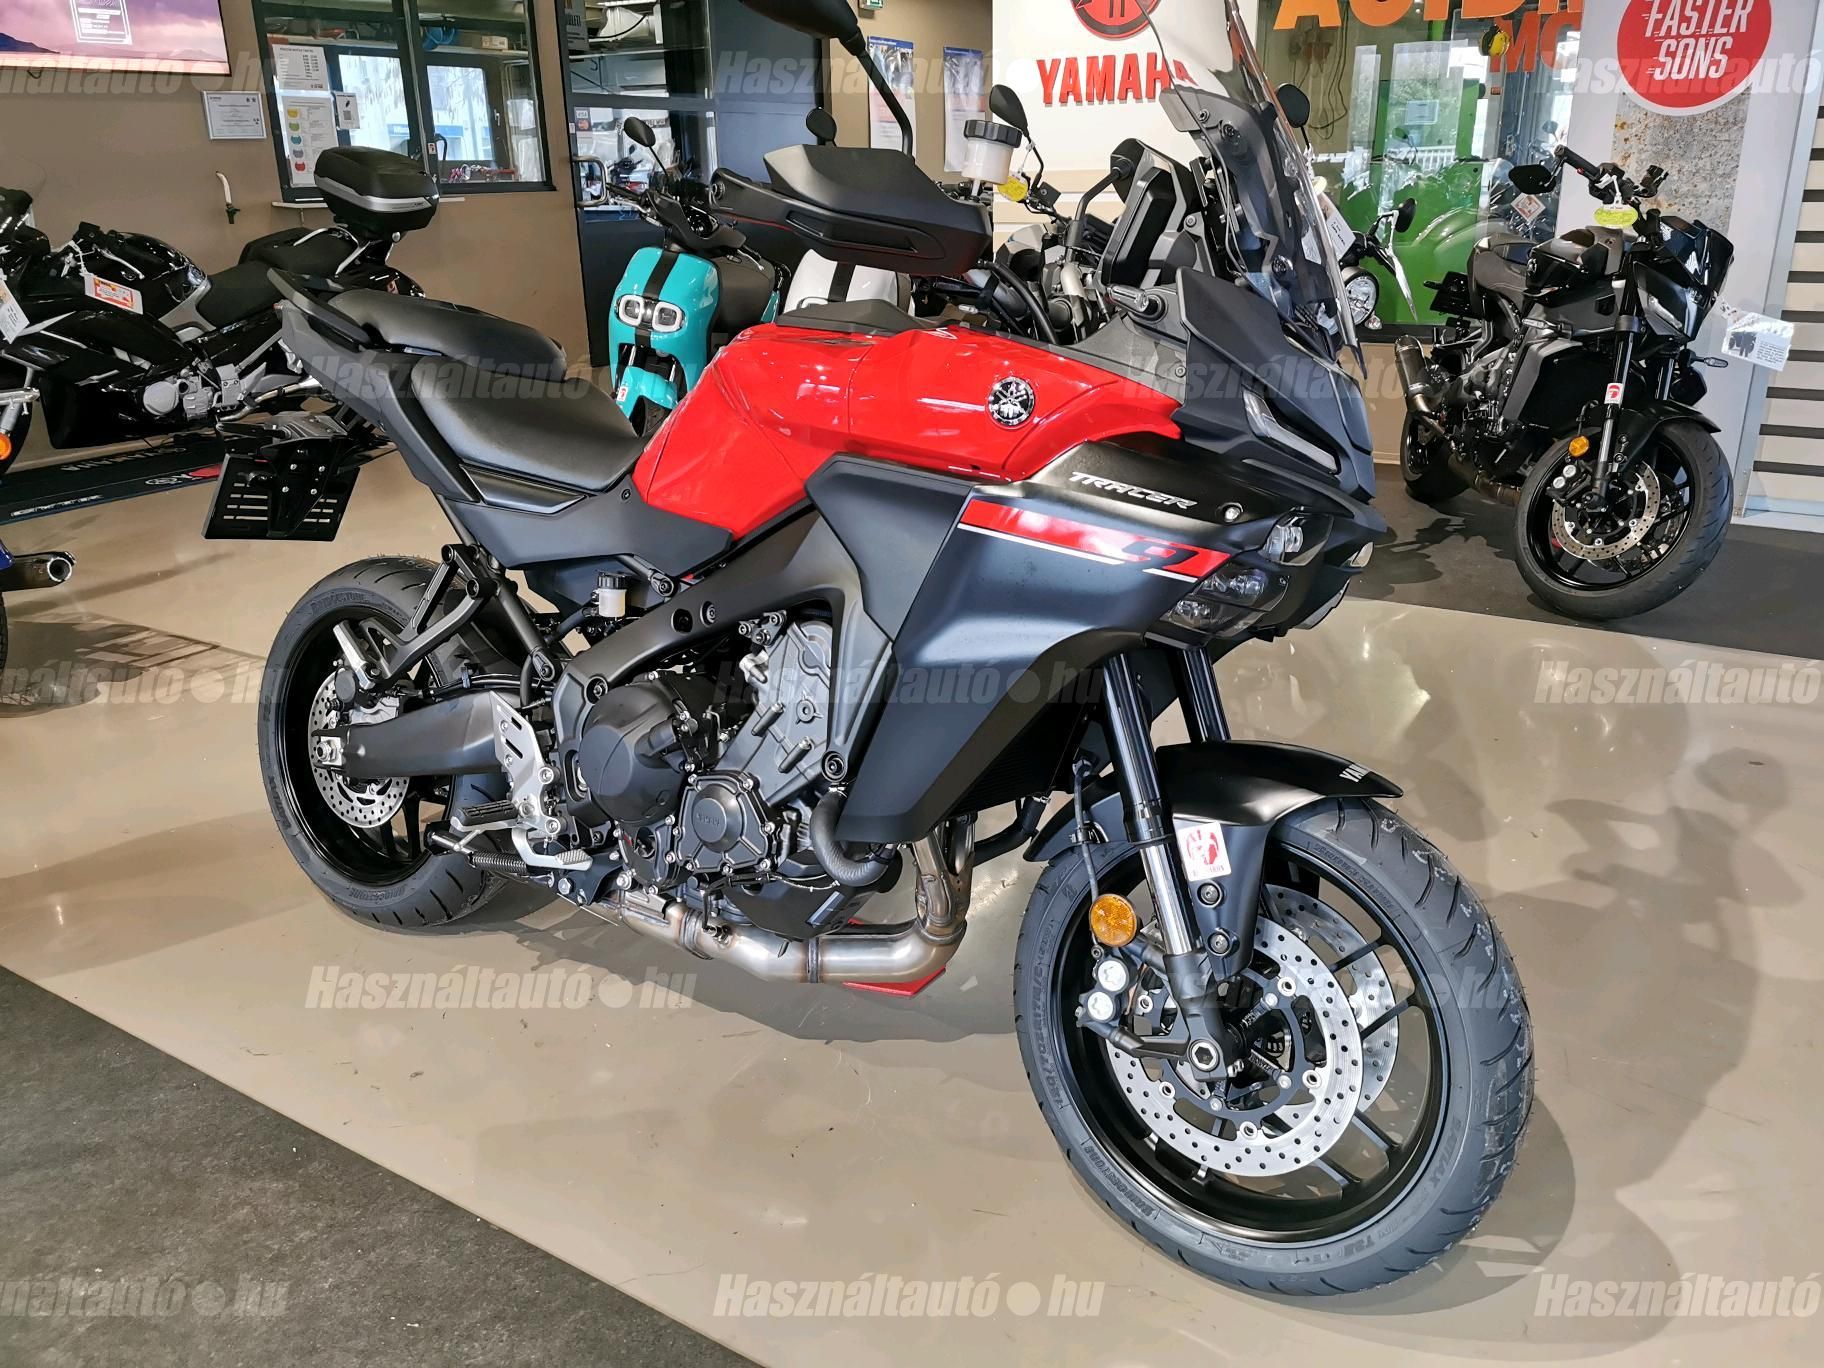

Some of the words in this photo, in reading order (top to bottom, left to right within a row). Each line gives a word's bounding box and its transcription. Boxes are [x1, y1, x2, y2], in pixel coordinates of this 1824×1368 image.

[1643, 0, 1754, 37] FASTER
[1036, 52, 1199, 106] YAMAHA
[1652, 36, 1734, 81] SONS
[1068, 471, 1198, 510] TRACER
